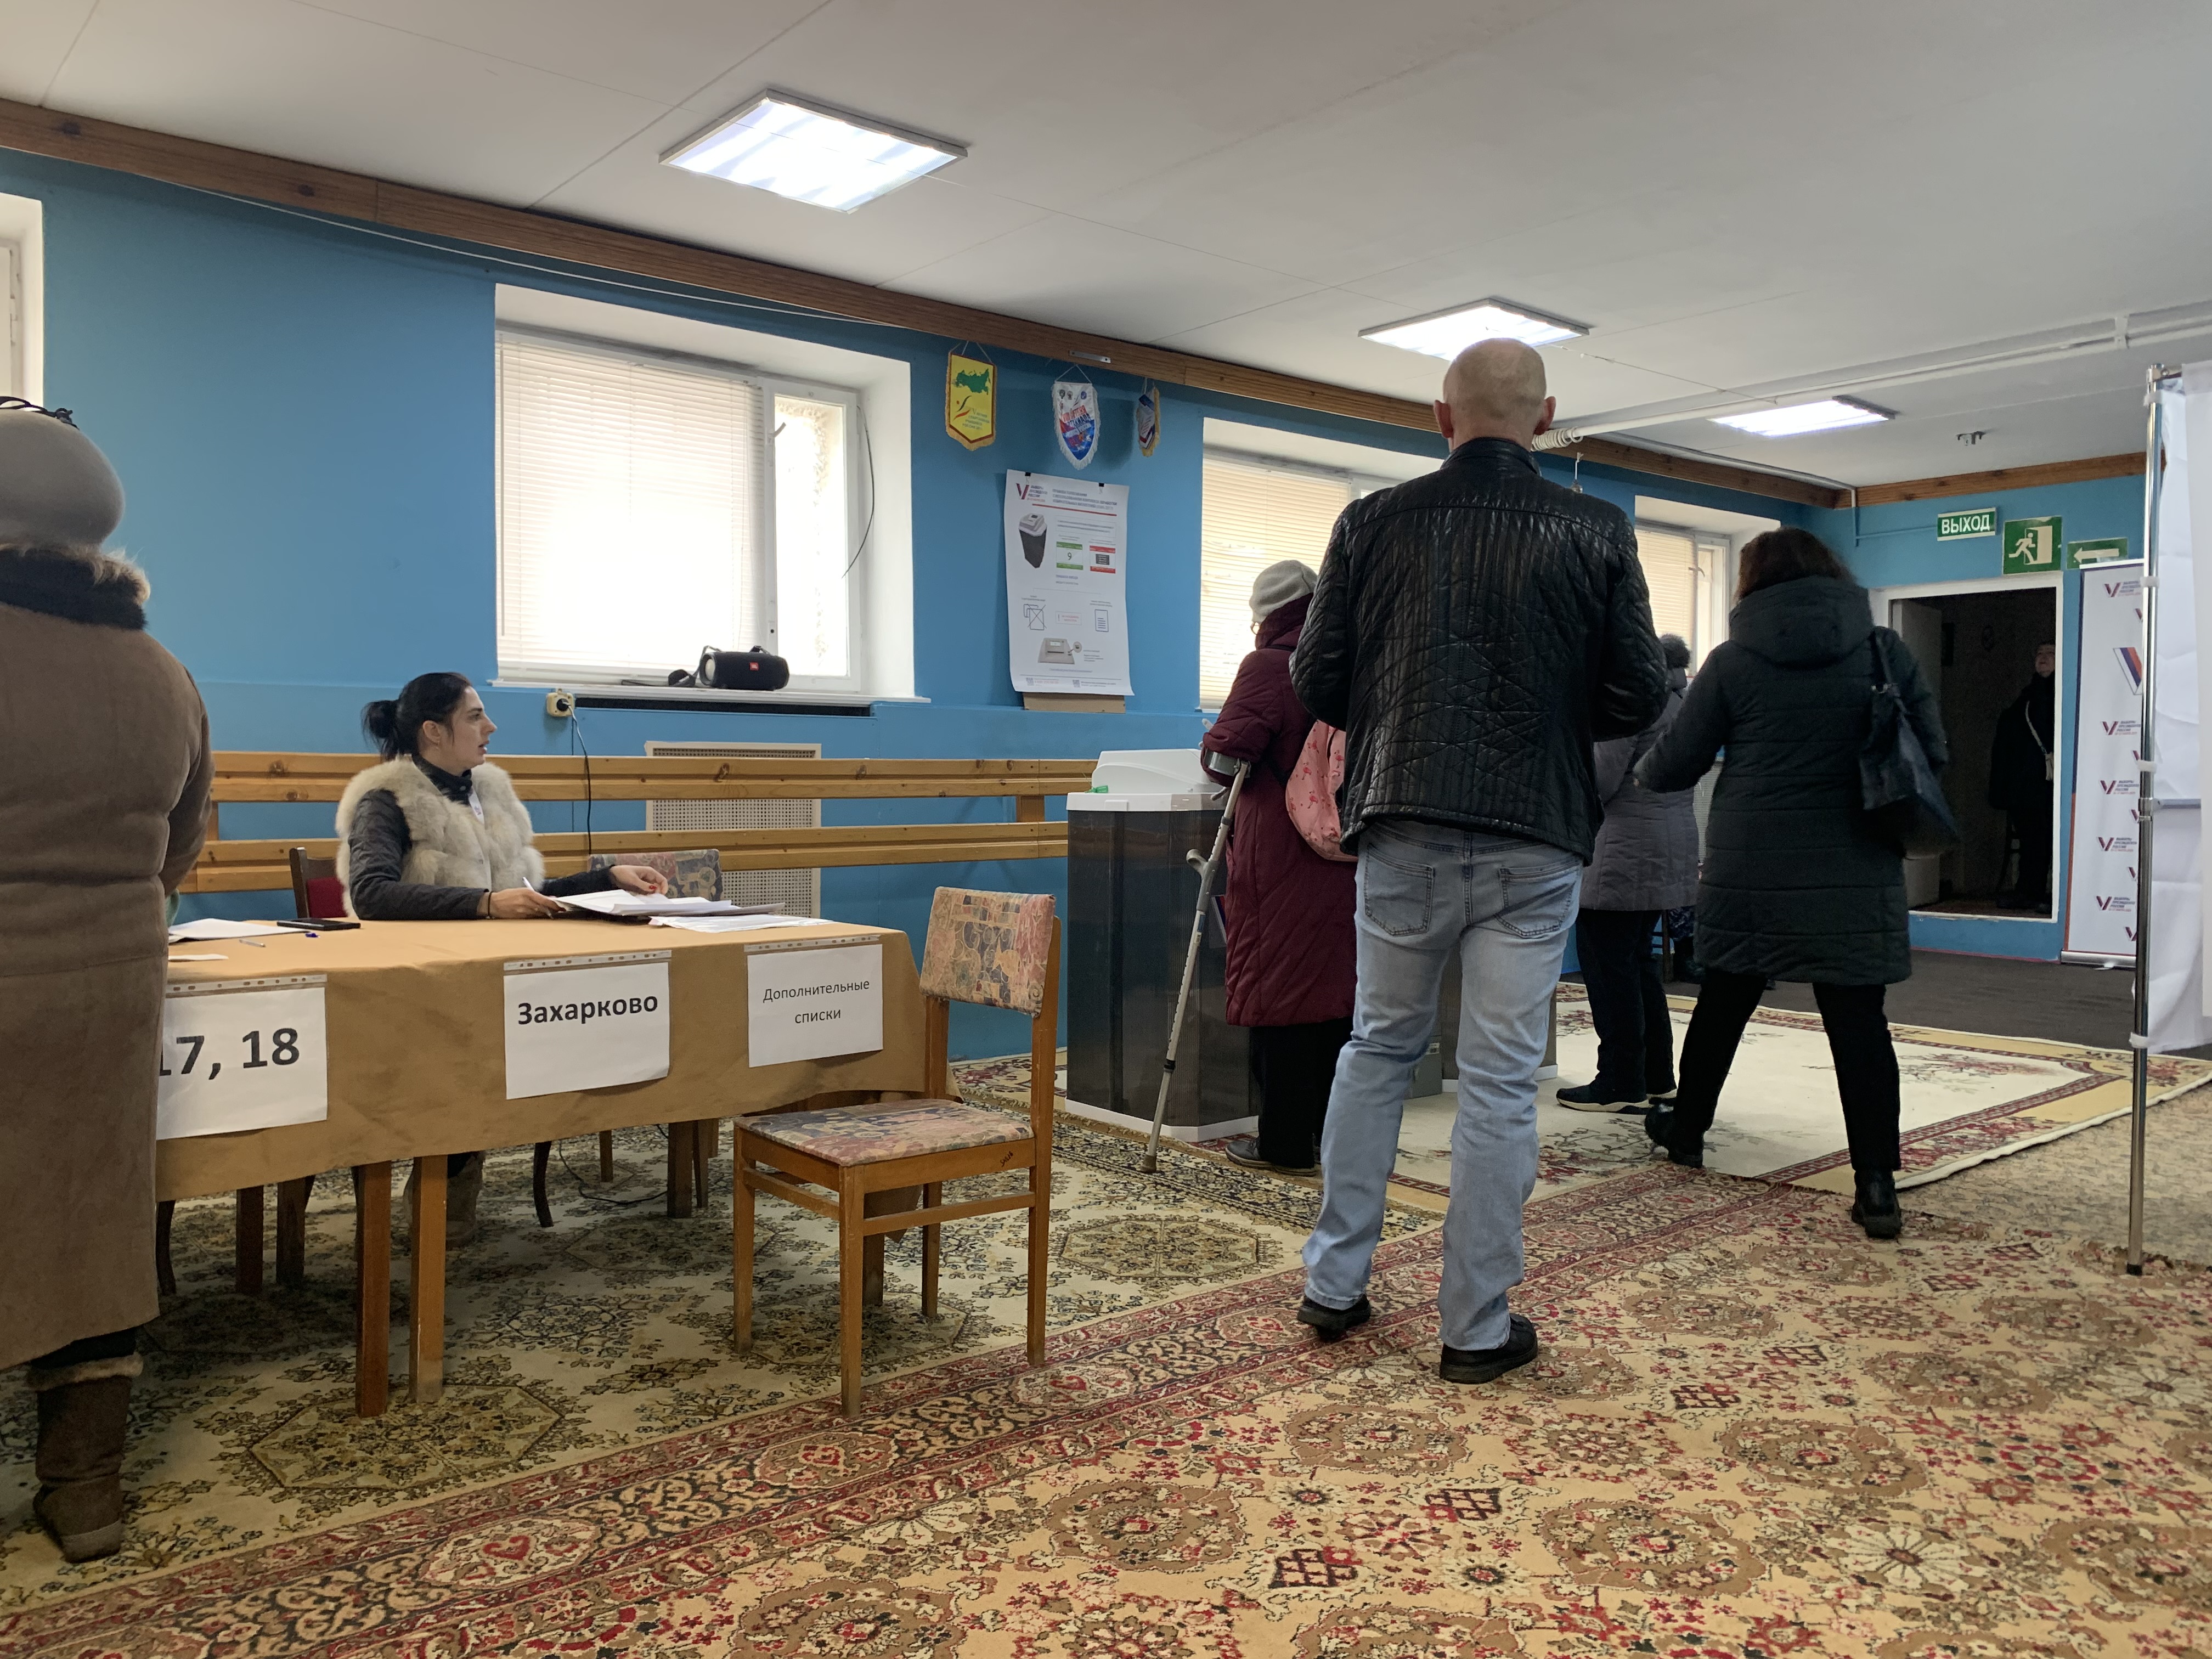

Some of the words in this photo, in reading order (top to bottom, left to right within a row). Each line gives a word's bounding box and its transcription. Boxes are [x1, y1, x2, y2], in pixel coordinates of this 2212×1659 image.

[1942, 515, 1990, 534] ВЫХОД
[1068, 552, 1072, 560] 9
[763, 981, 870, 1003] Дополнительные
[518, 996, 658, 1025] Захарково
[795, 1009, 841, 1024] списки
[242, 1028, 300, 1068] 18
